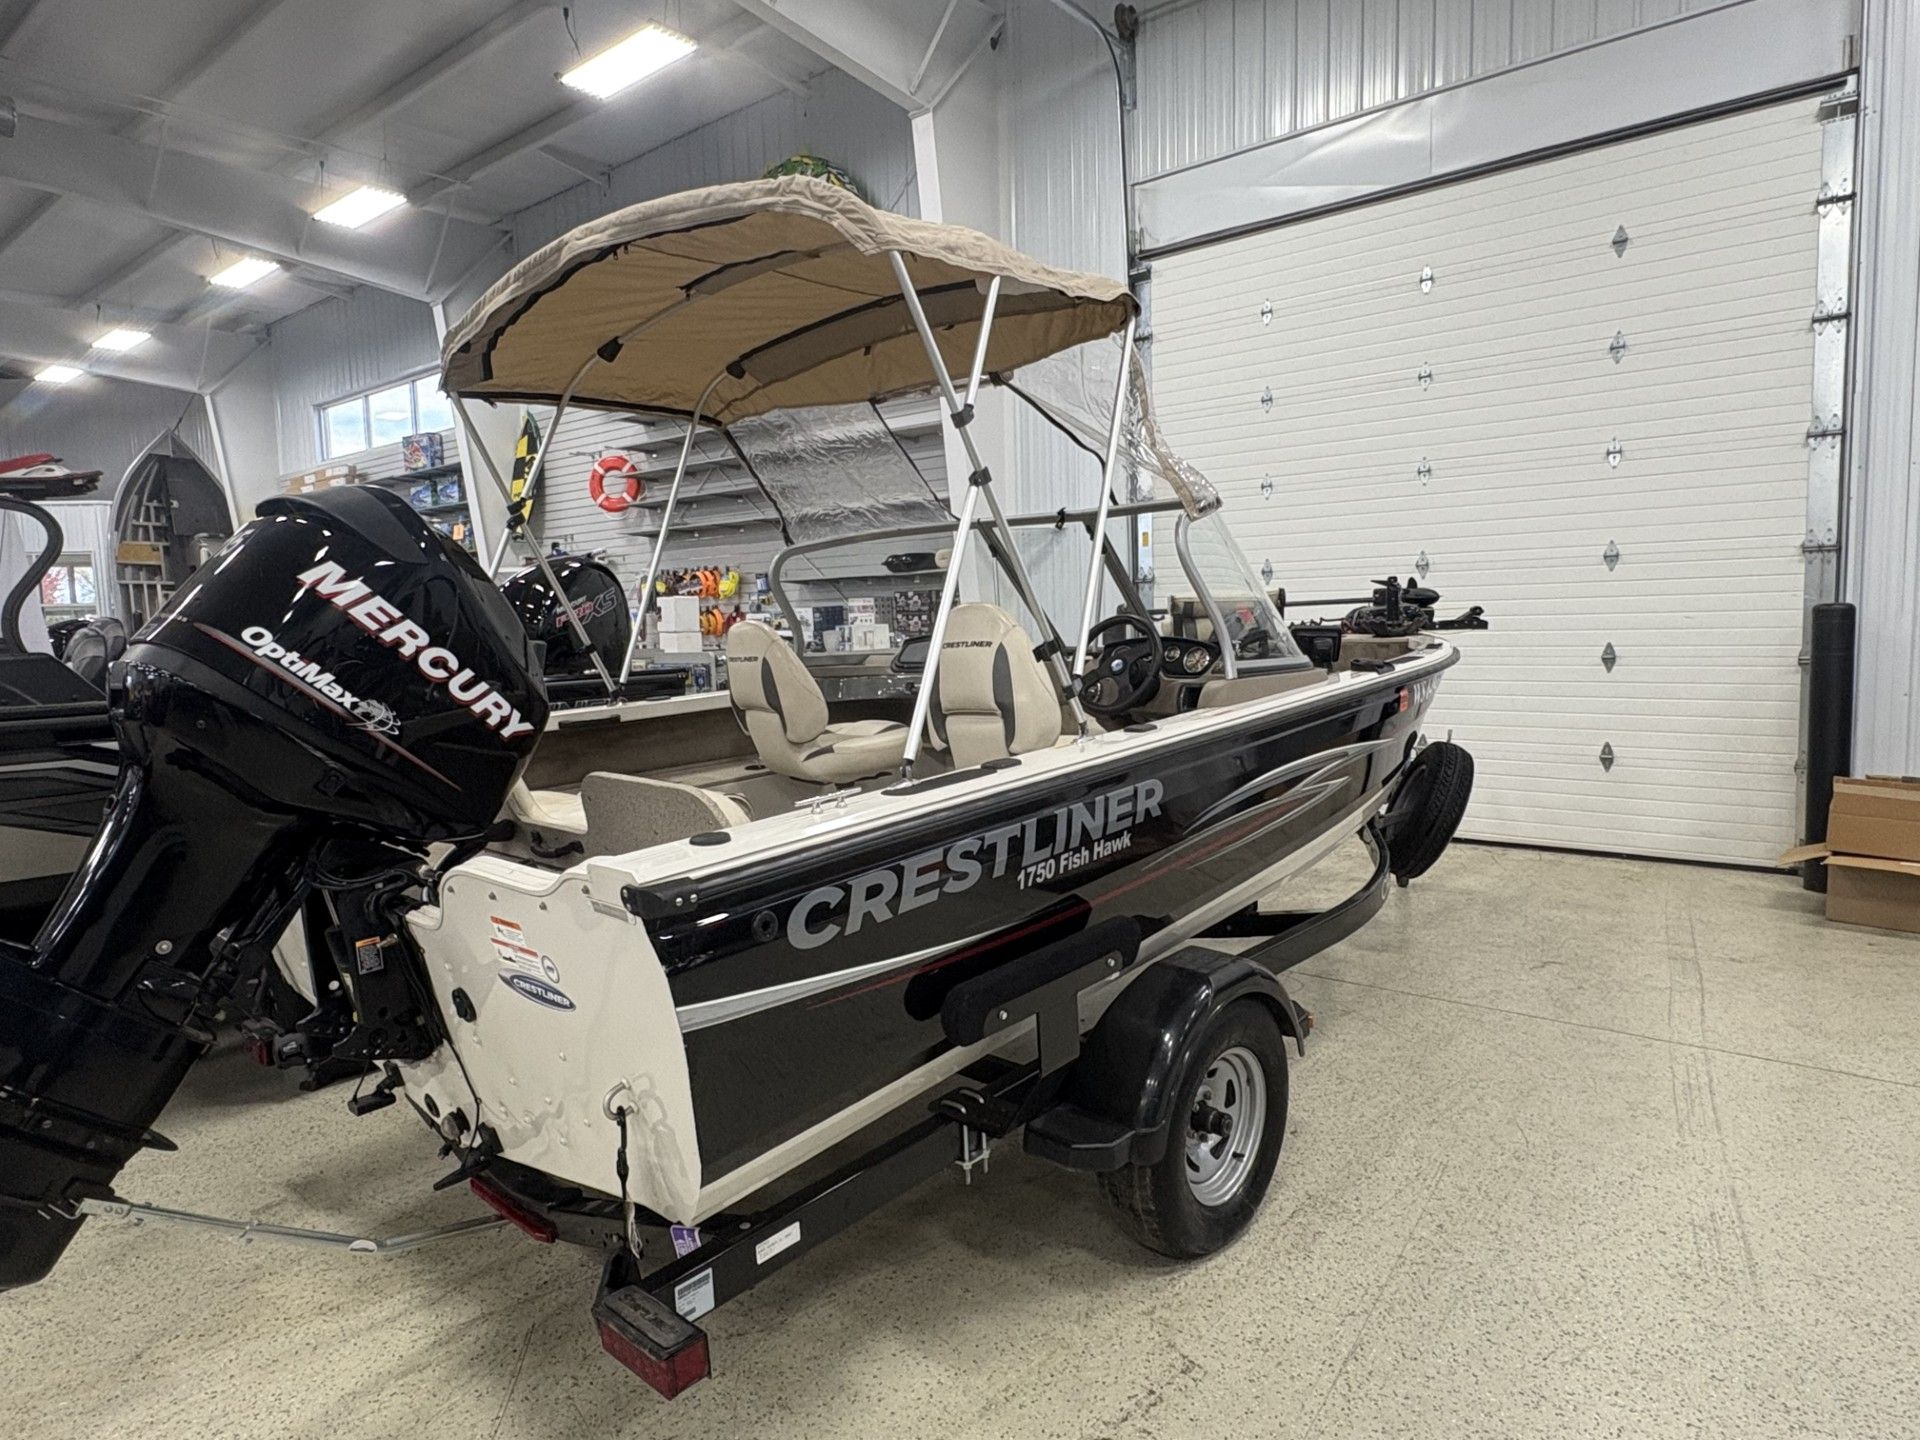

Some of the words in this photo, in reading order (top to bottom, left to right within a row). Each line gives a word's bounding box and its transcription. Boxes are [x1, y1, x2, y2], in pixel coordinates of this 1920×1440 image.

[240, 625, 361, 712] OptiMax
[296, 560, 535, 742] MERCURY
[786, 778, 1164, 950] CRESTLINER
[1017, 858, 1056, 890] 1750
[1059, 846, 1090, 875] Fish
[1092, 830, 1132, 861] Hawk
[513, 978, 571, 1007] CRESTLINER
